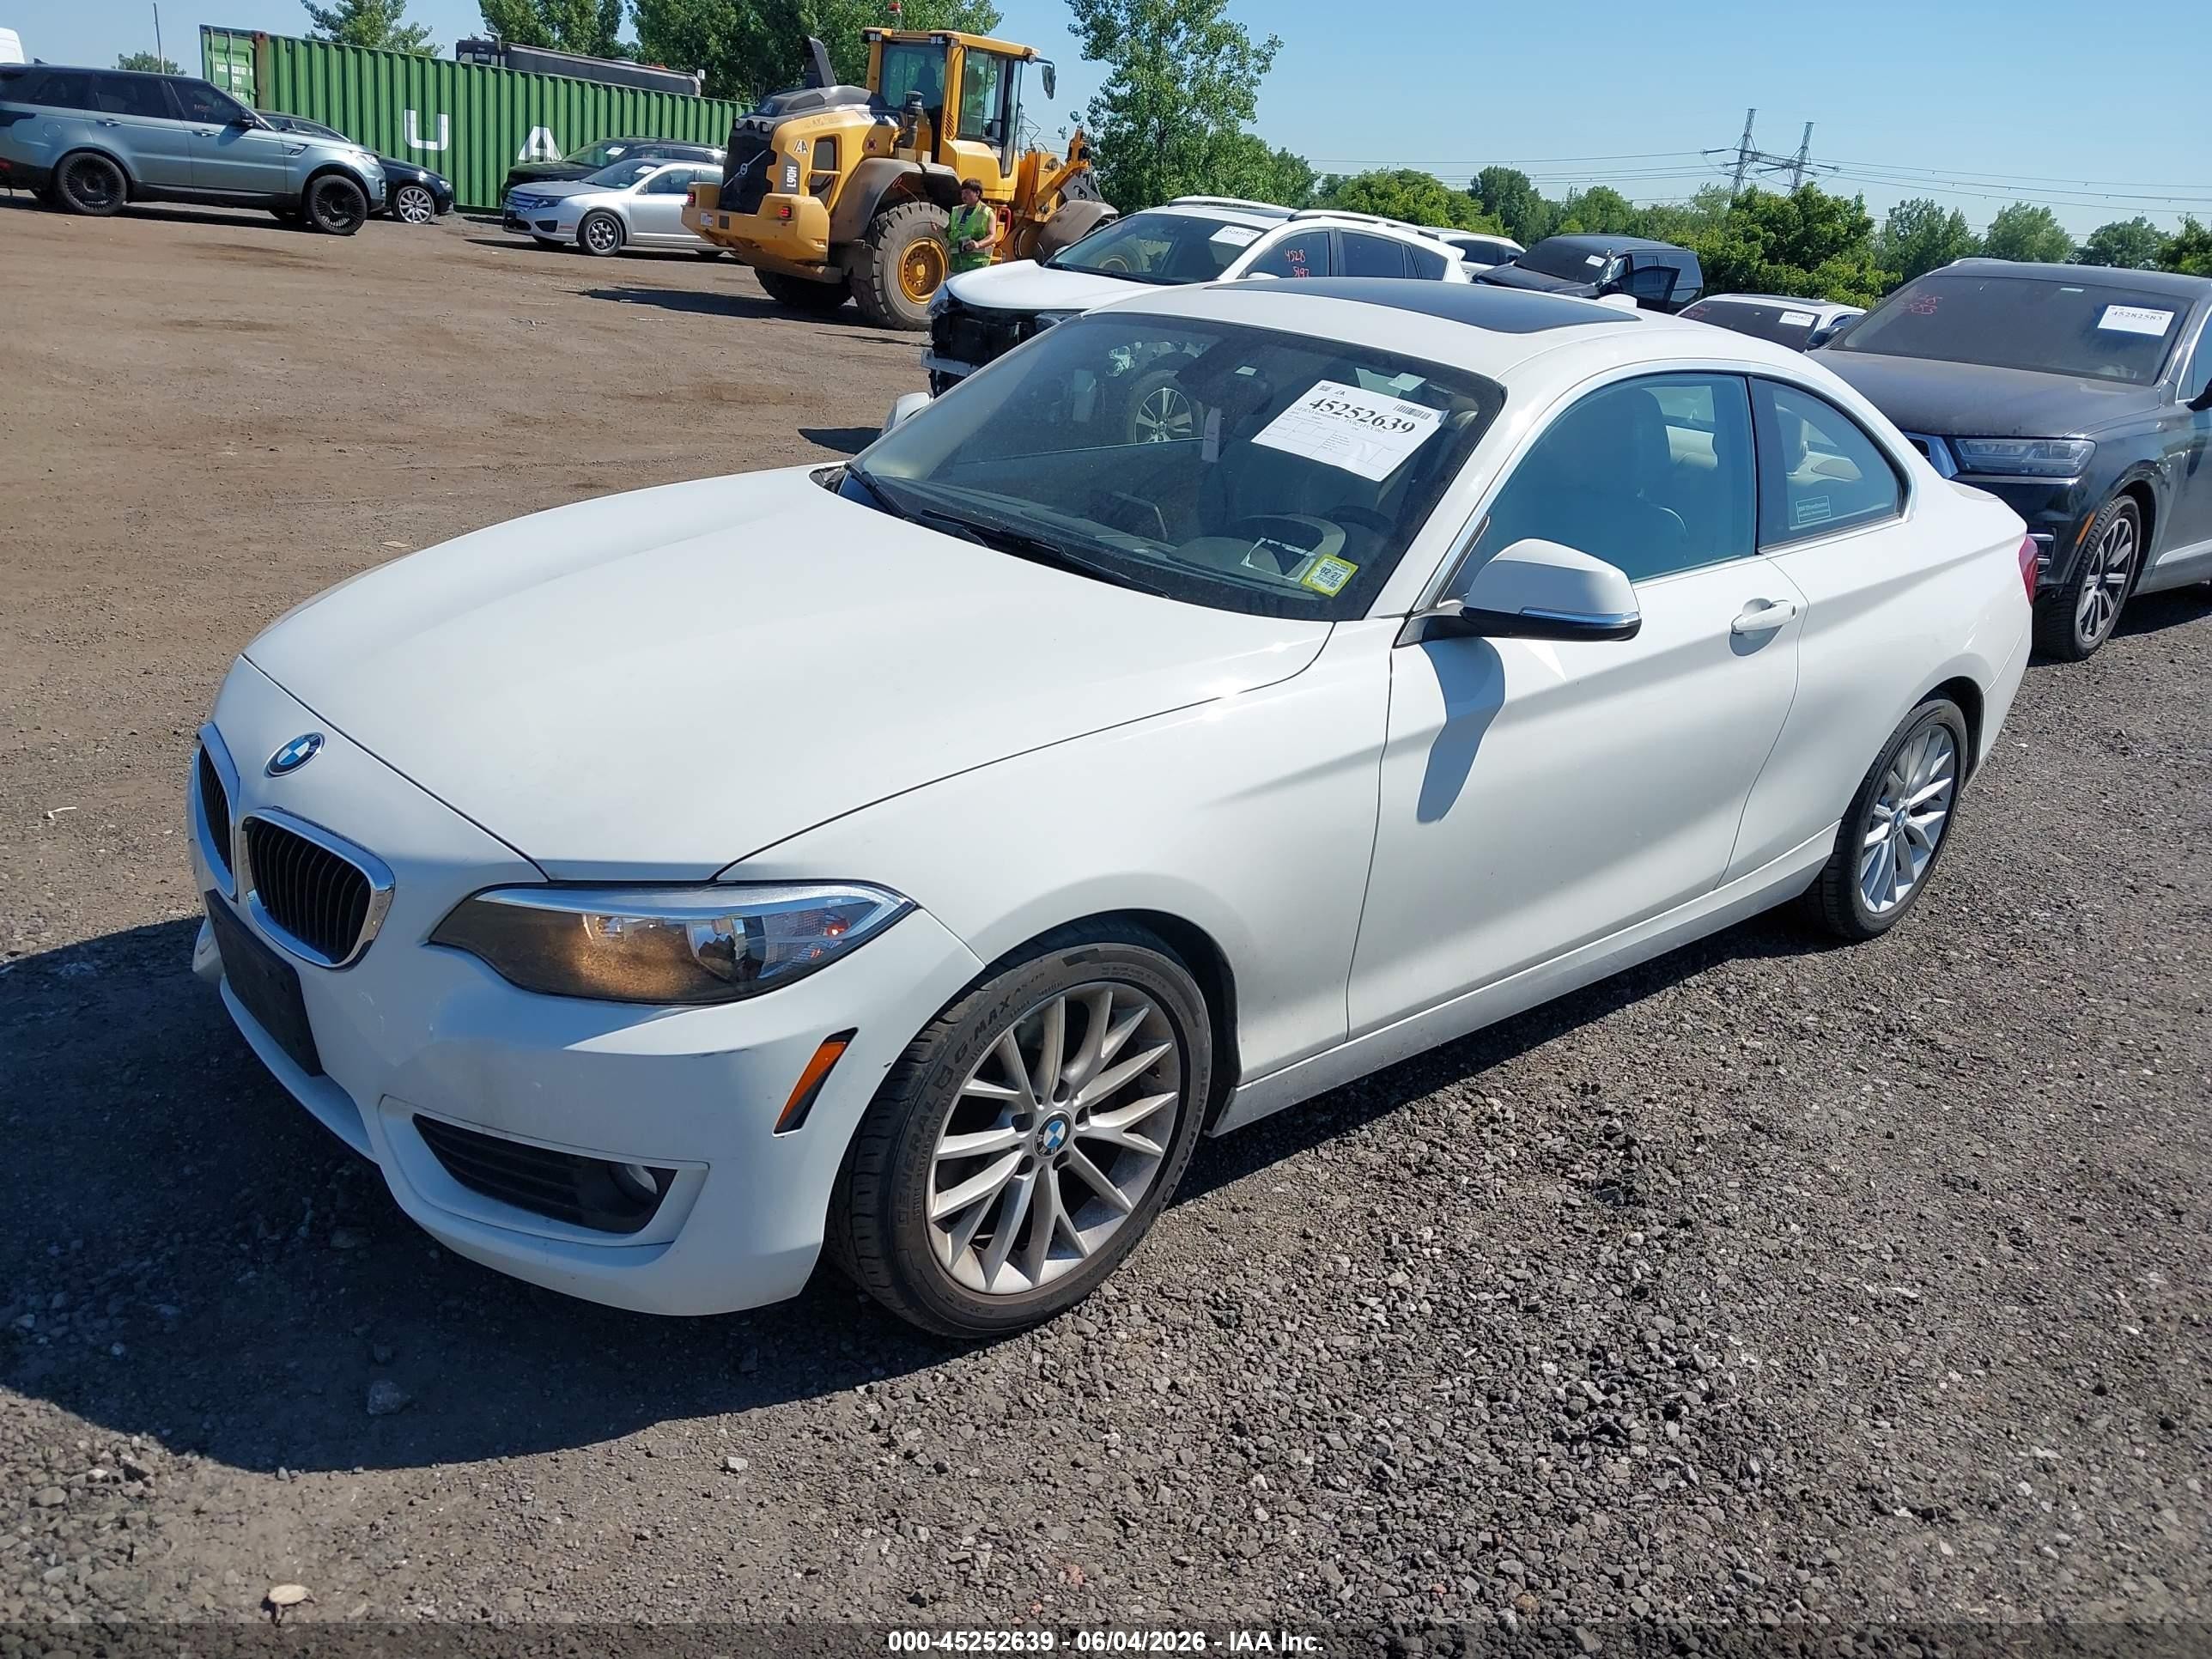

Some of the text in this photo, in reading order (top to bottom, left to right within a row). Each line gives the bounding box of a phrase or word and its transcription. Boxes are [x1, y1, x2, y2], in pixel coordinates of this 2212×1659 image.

[404, 109, 562, 161] U A
[787, 165, 797, 188] L90H
[1285, 248, 1305, 263] 4528
[1309, 398, 1416, 434] 45252639
[1320, 567, 1332, 575] 02
[1330, 571, 1342, 581] 27
